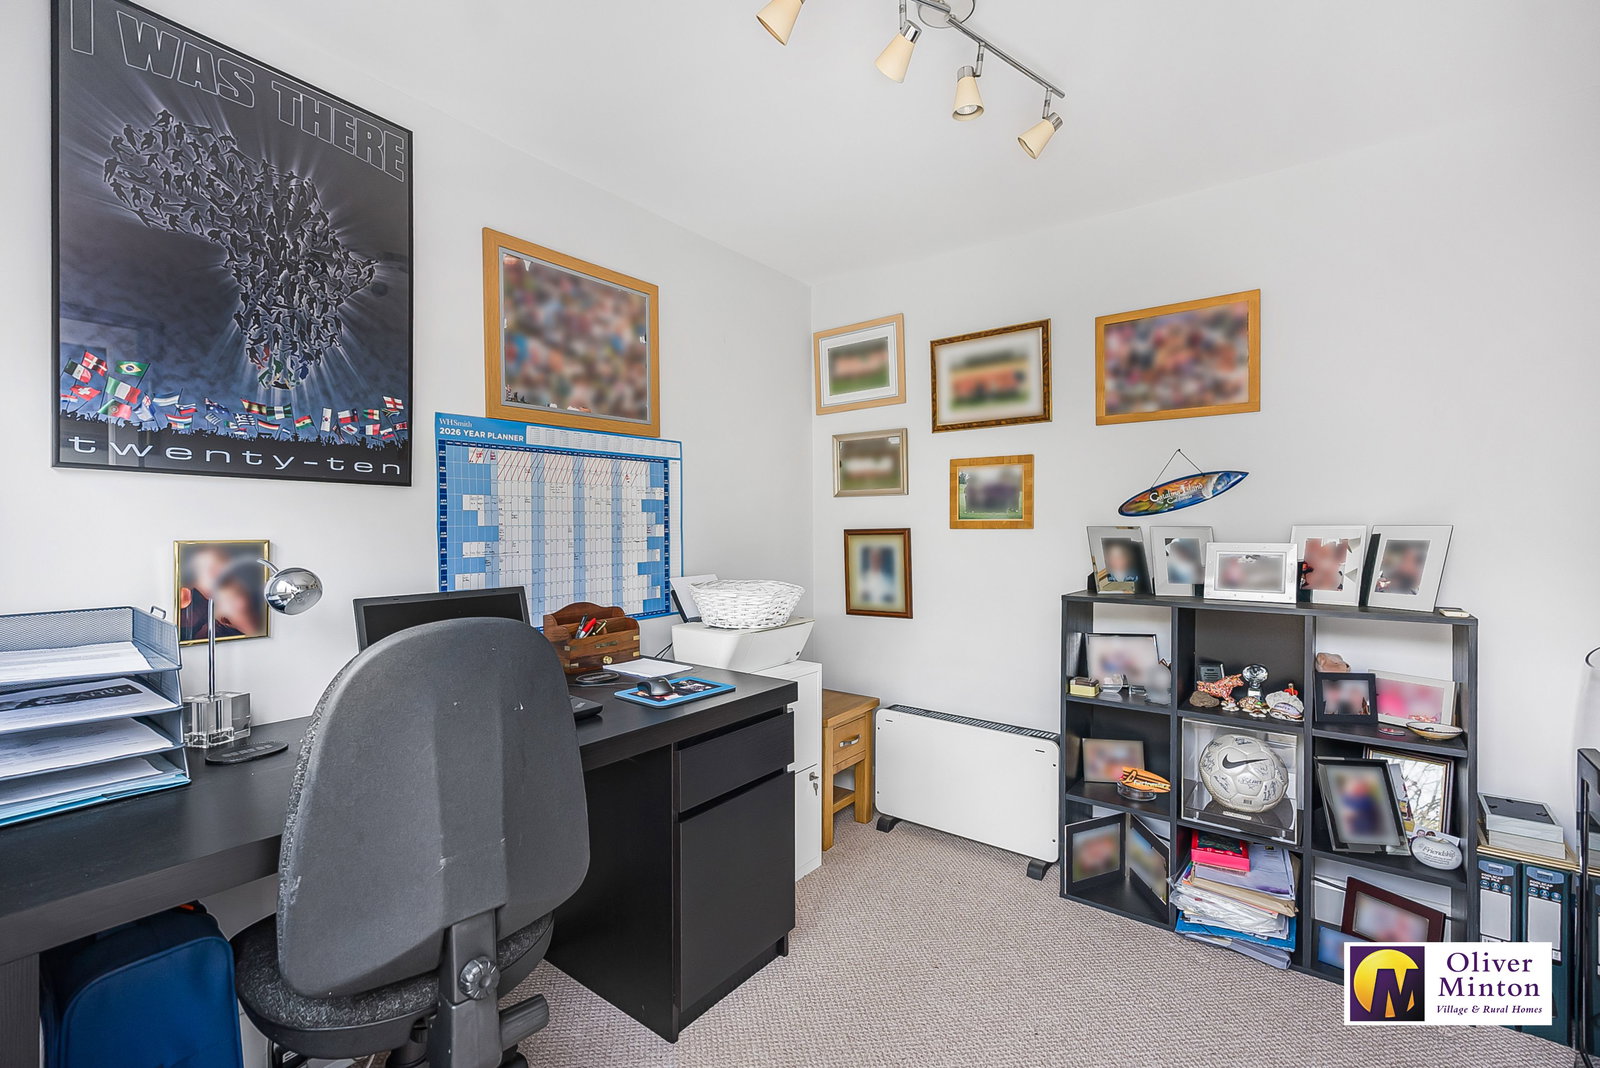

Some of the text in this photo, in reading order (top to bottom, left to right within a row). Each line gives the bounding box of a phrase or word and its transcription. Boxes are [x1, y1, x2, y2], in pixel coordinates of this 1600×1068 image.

[70, 0, 406, 183] I WAS THERE
[439, 418, 472, 428] WHSmith
[439, 427, 524, 442] 2026 YEAR PLANNER
[68, 435, 402, 475] twenty-ten
[1422, 846, 1456, 859] Friendship
